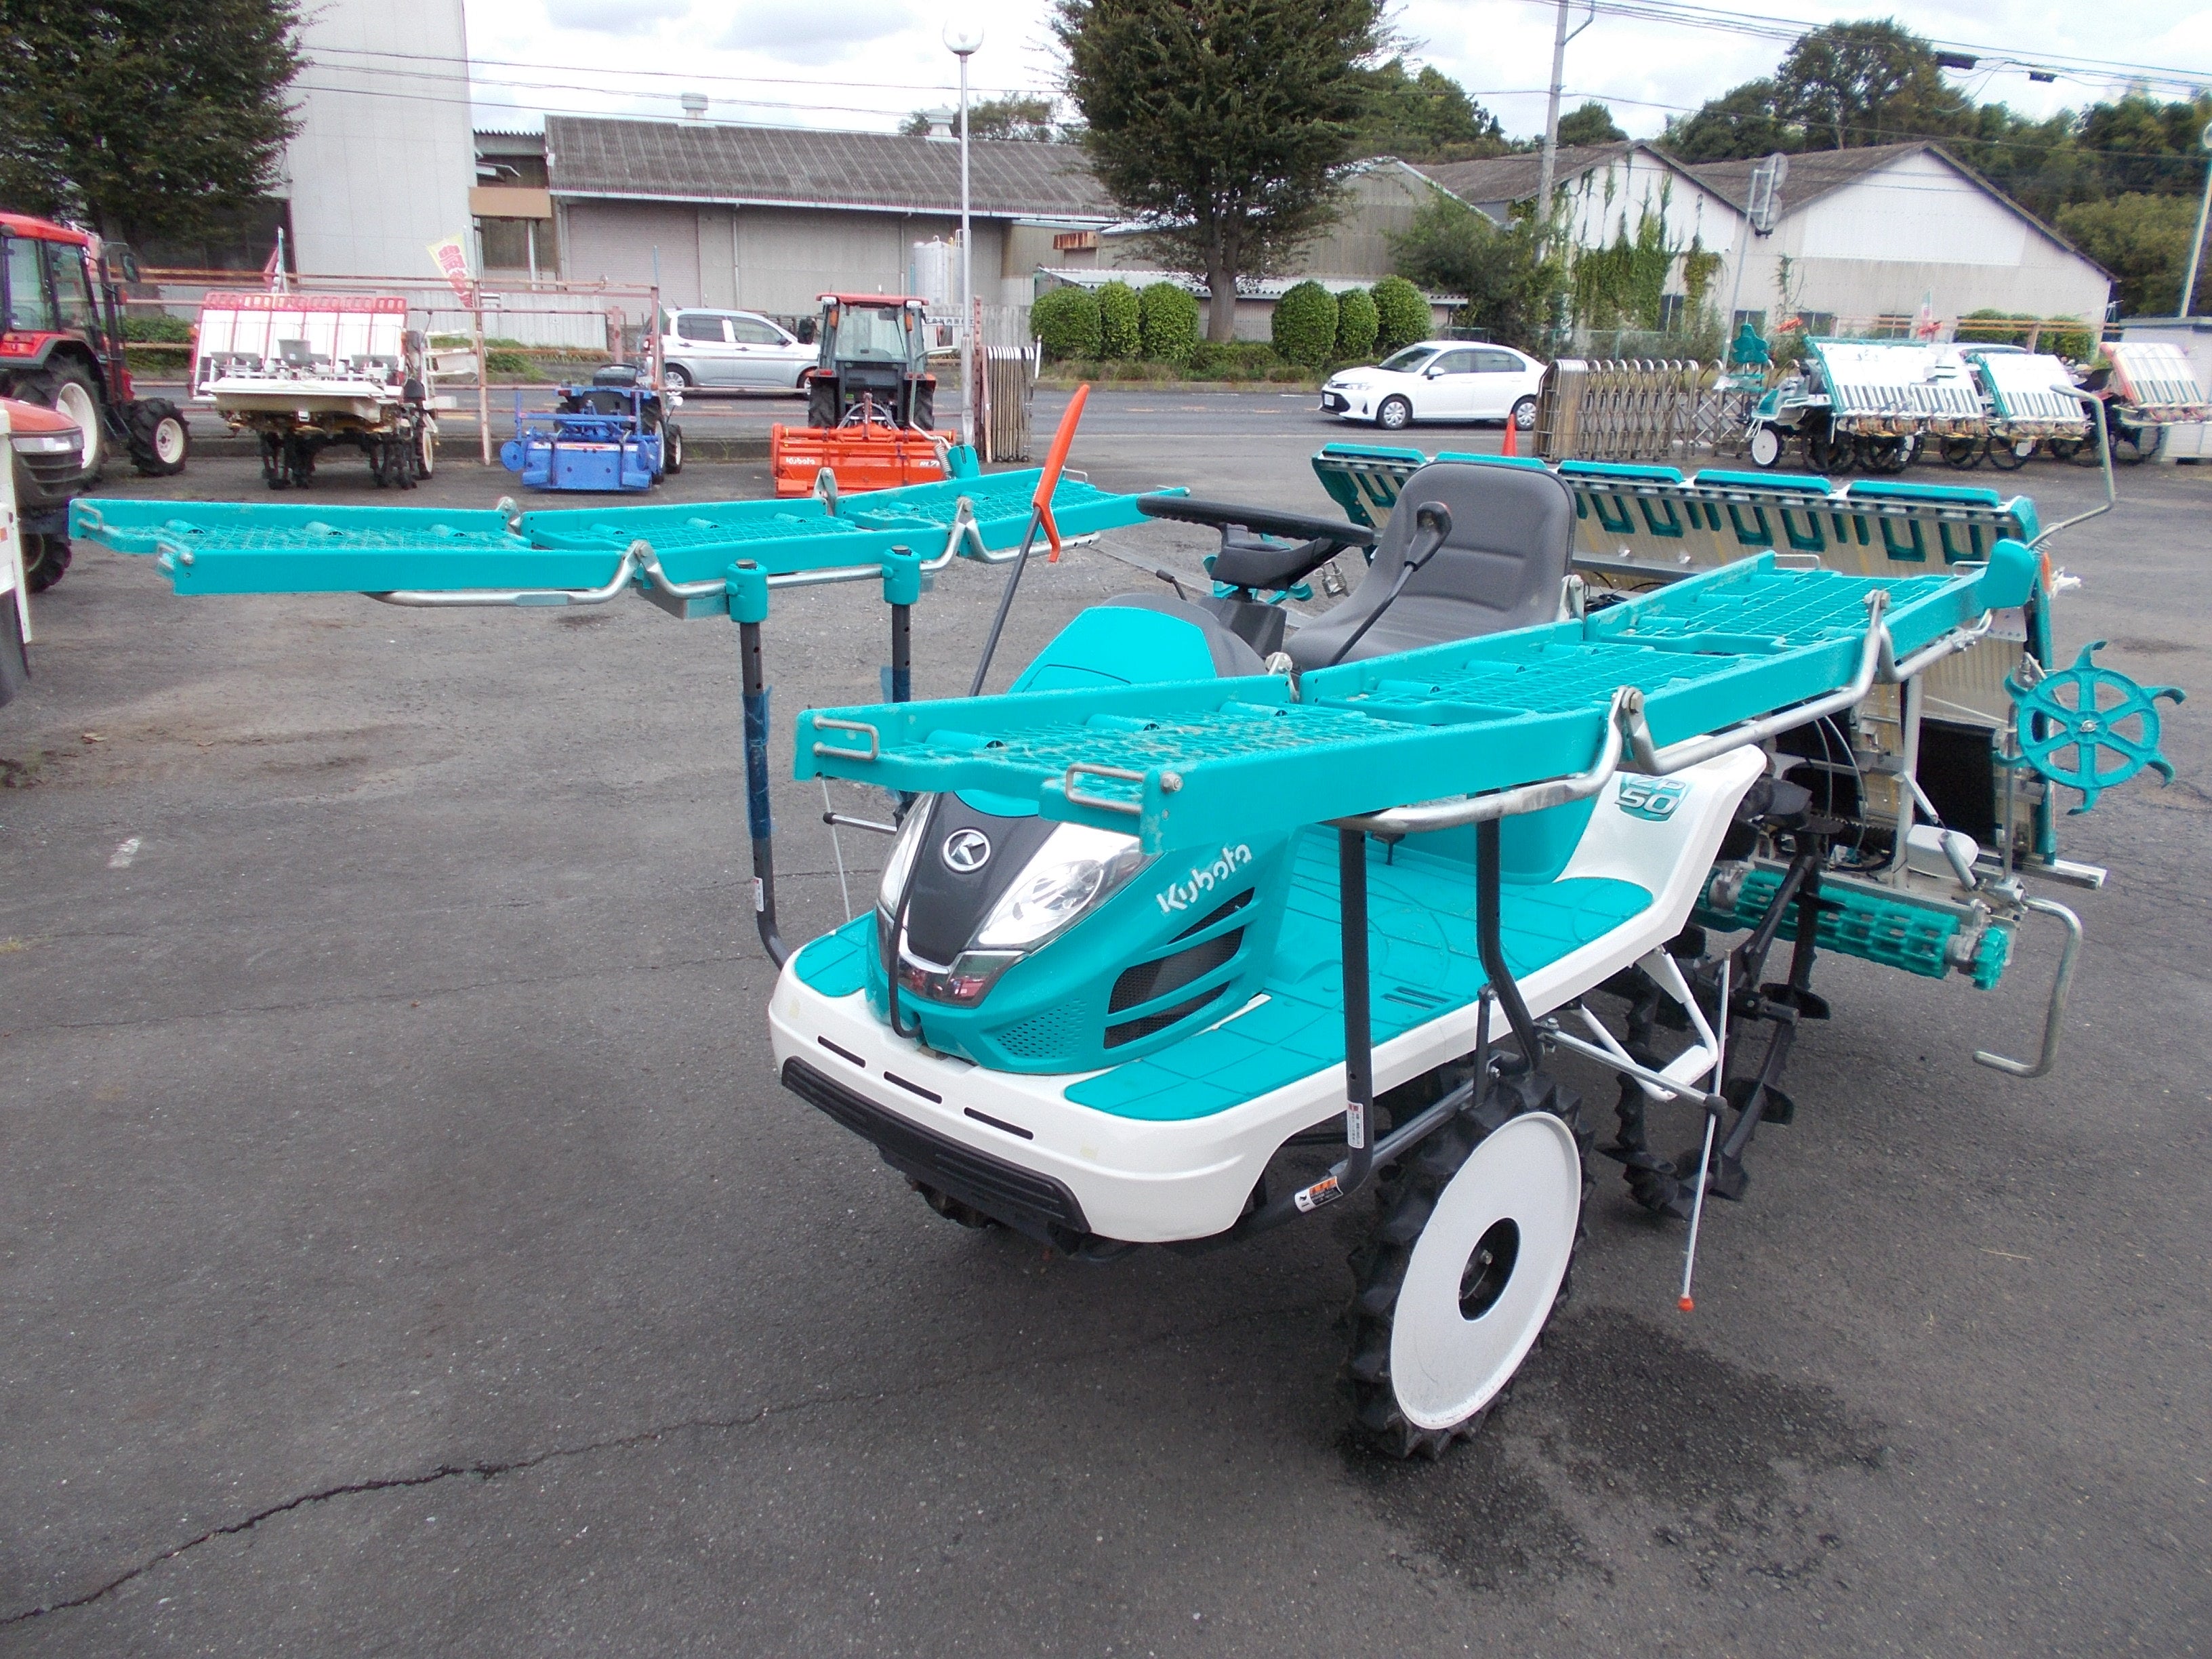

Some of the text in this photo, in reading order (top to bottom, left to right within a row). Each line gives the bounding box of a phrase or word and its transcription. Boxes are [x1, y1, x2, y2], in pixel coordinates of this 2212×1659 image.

[785, 457, 815, 465] Kubota
[1614, 787, 1679, 815] 50
[1155, 844, 1252, 913] Kubota
